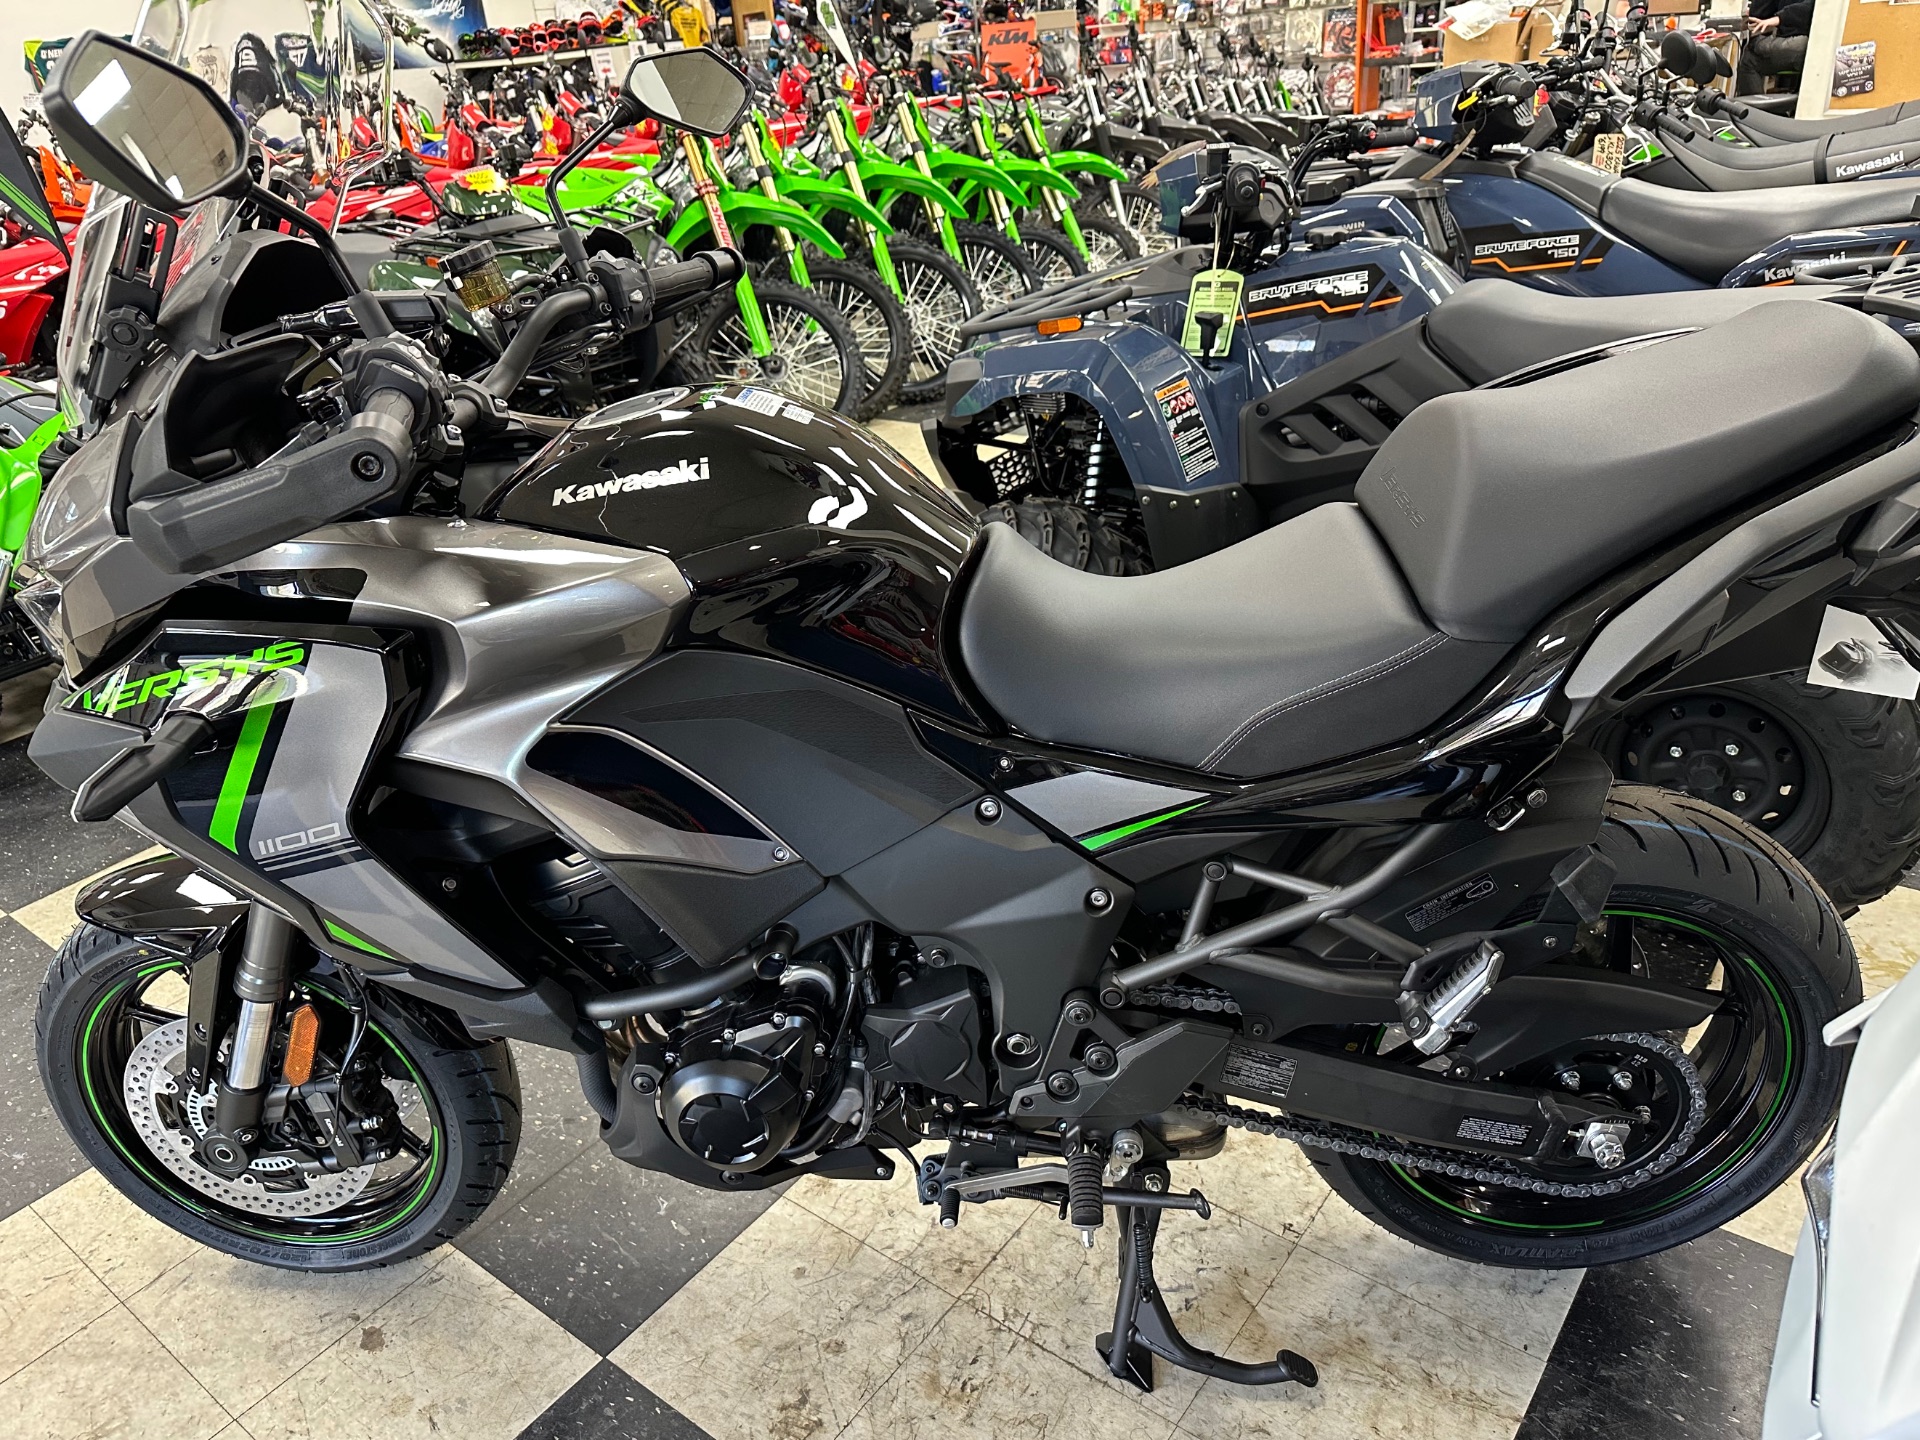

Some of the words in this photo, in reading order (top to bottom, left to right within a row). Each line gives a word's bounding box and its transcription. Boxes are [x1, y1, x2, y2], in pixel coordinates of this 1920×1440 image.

[988, 28, 1028, 46] KTM
[1604, 141, 1615, 170] KLX300
[1615, 136, 1625, 155] 2025
[1836, 150, 1904, 178] Kawasaki
[1547, 246, 1579, 258] 750
[552, 457, 710, 507] Kawasaki
[83, 641, 305, 714] VERSYS
[258, 822, 341, 856] 1100
